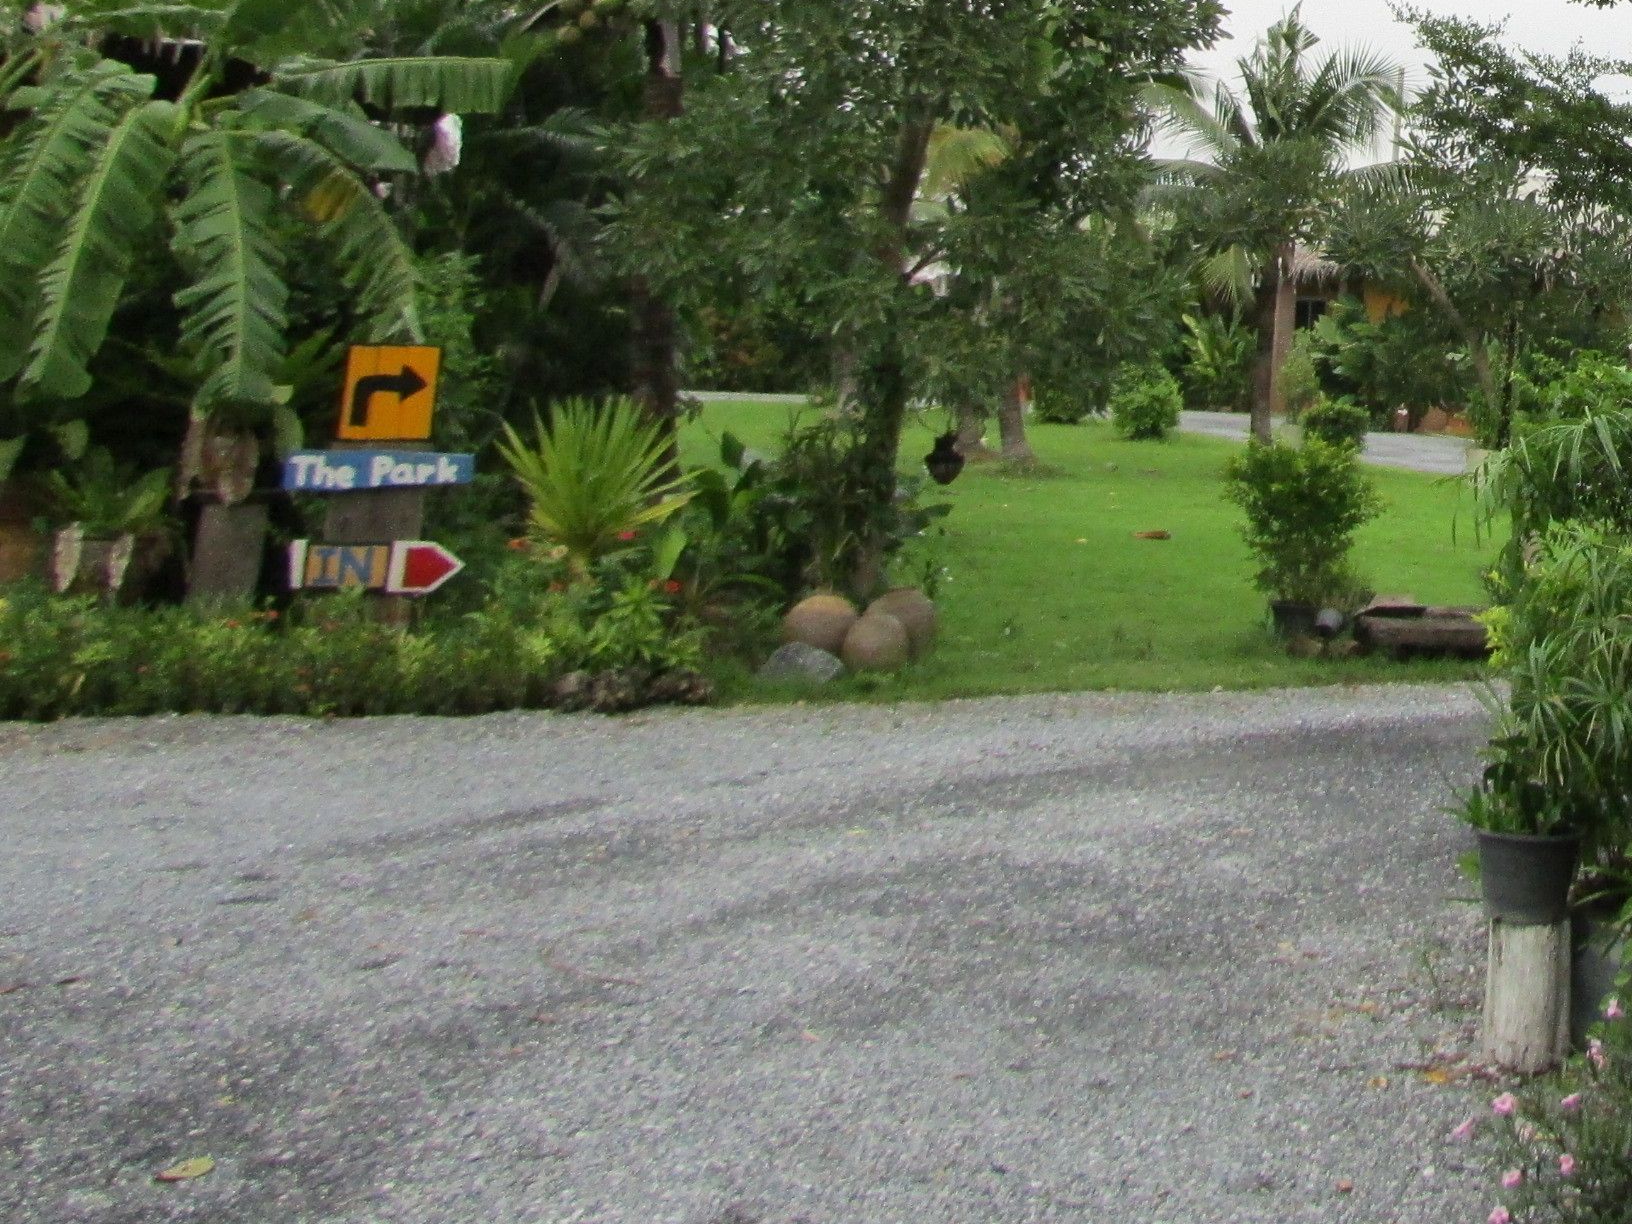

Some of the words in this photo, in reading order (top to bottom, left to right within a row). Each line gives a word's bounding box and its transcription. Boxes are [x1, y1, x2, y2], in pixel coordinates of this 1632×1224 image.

[290, 455, 356, 488] The
[370, 455, 460, 487] Park
[312, 545, 376, 586] IN
